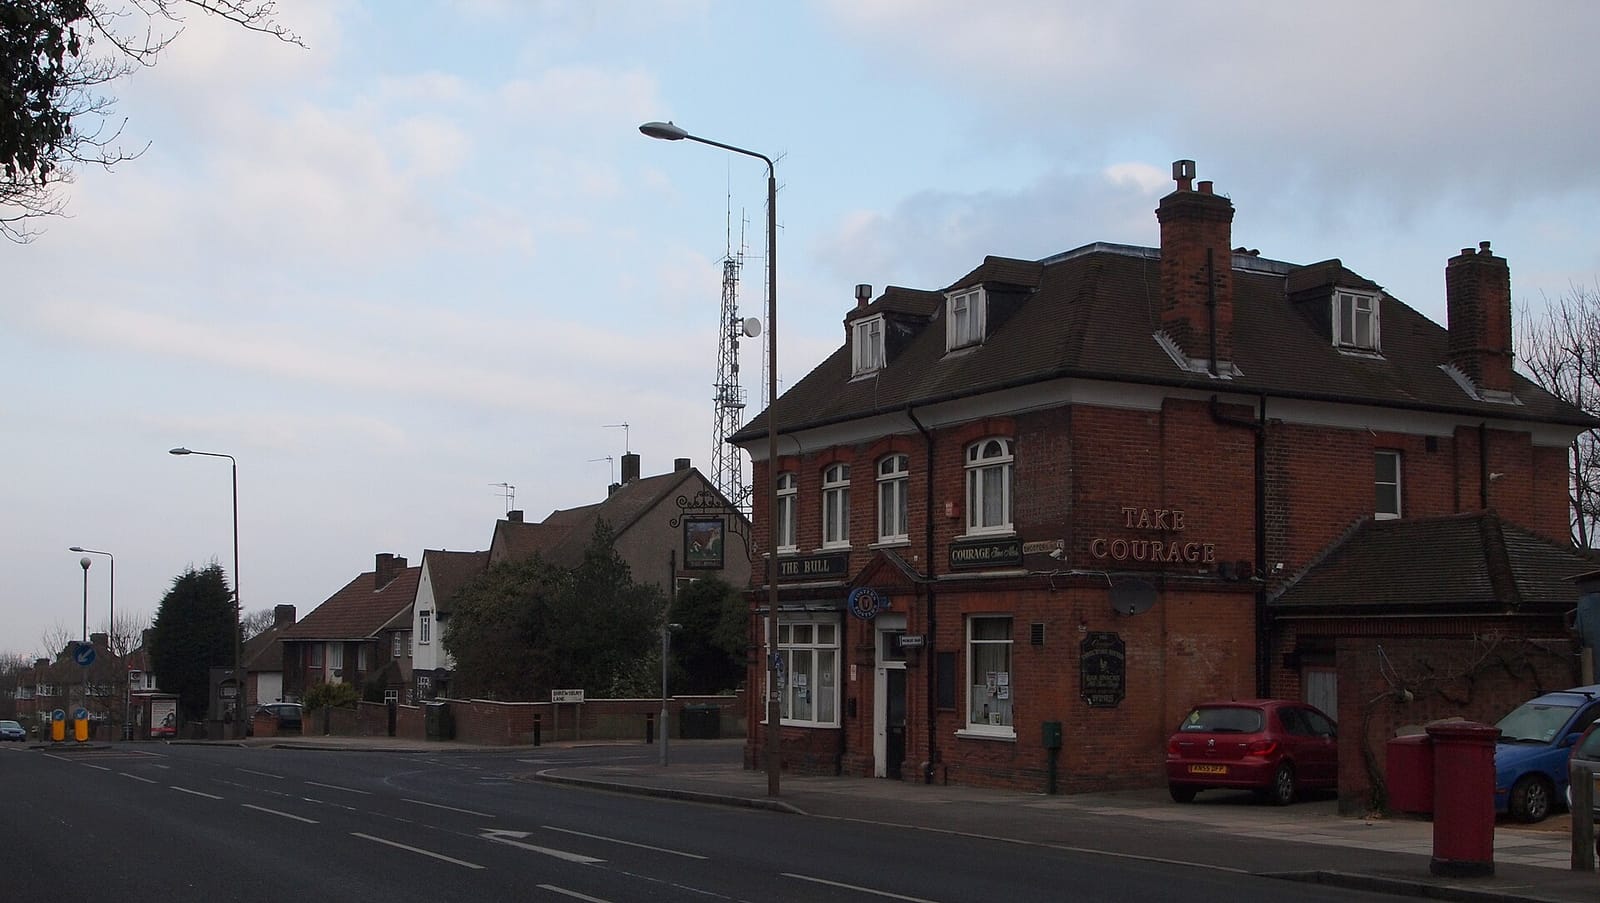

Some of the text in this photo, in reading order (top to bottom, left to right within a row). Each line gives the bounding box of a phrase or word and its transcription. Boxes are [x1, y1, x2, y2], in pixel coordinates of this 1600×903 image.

[1121, 507, 1184, 530] TAKE
[952, 547, 990, 560] COURAGE
[1091, 538, 1216, 563] COURAGE
[782, 559, 830, 575] THE BULL
